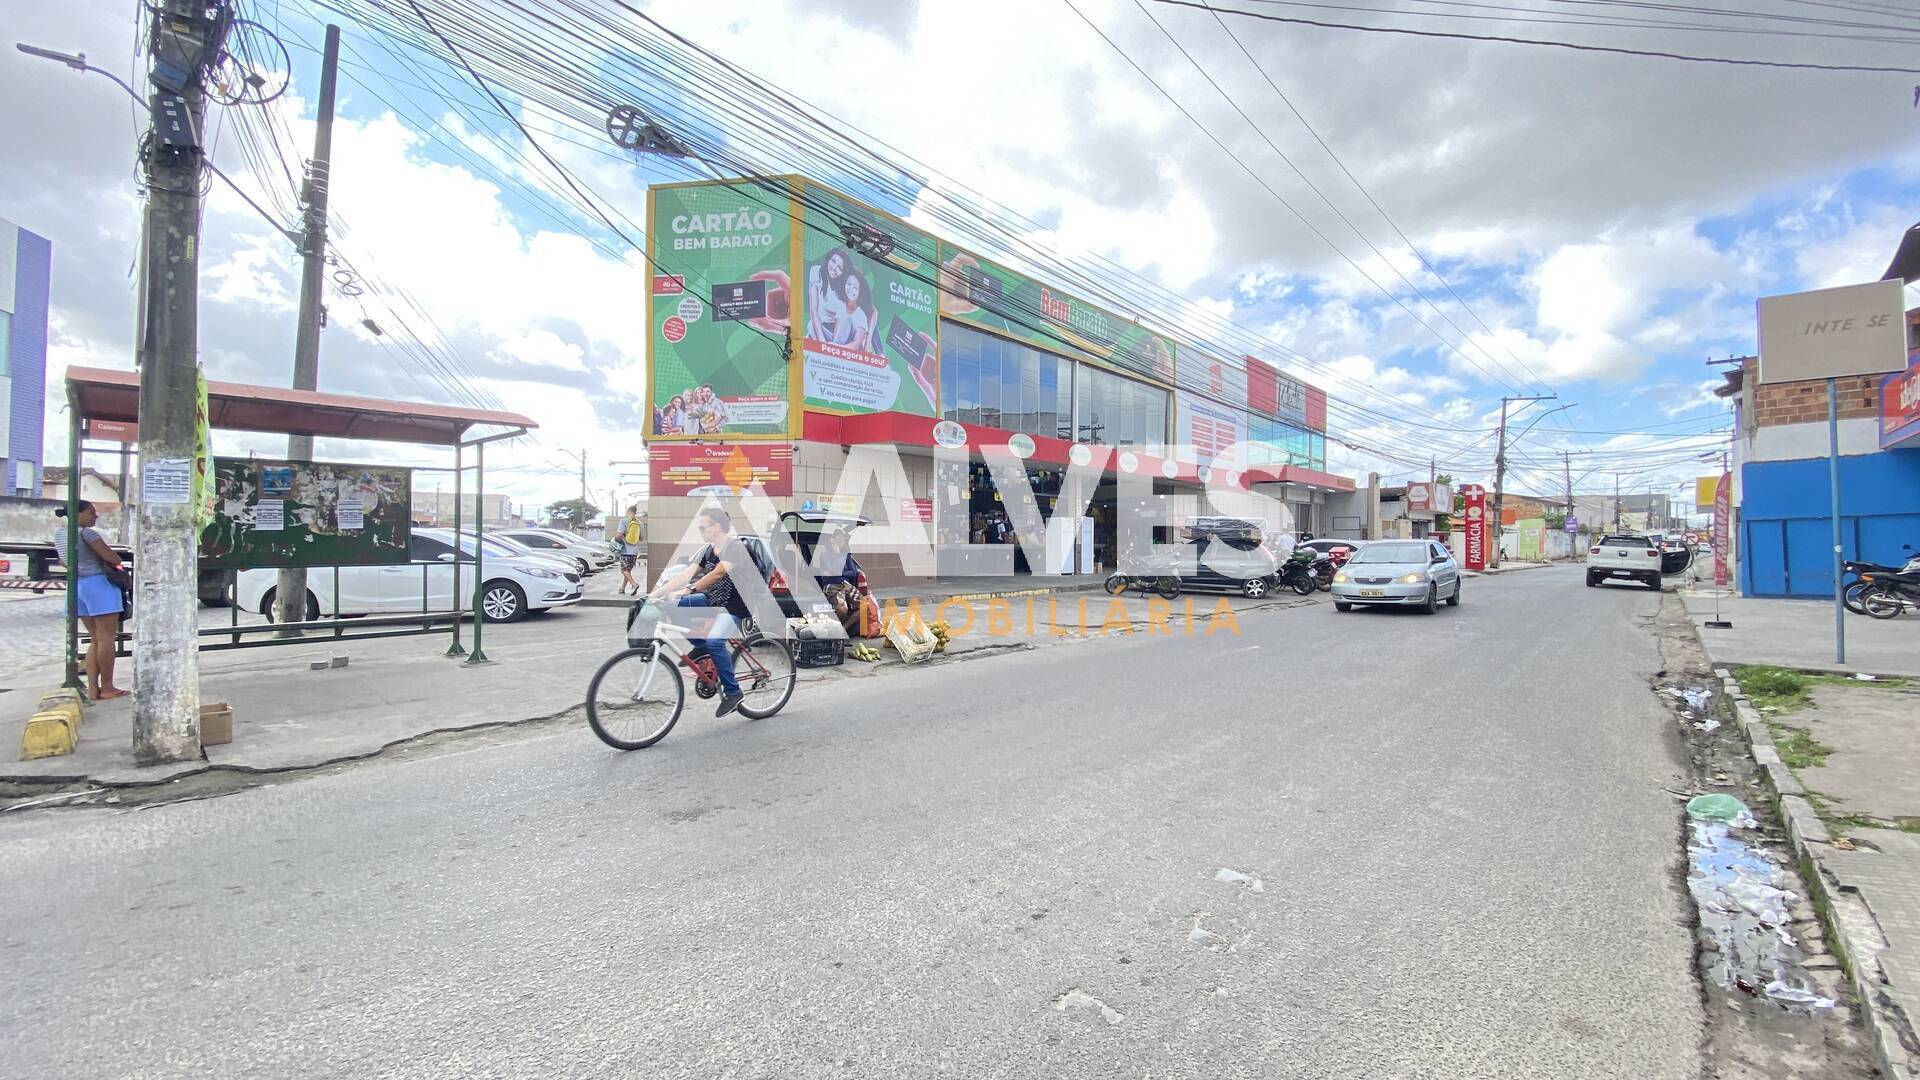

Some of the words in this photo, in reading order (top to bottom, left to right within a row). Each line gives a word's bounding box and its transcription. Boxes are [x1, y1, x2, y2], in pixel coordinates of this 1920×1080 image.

[672, 207, 772, 234] CARTÃO
[674, 237, 706, 250] BEM
[710, 234, 772, 249] BARATO
[890, 282, 932, 305] CARTÃO
[890, 294, 905, 305] BEM
[906, 300, 932, 314] BARATO
[1866, 314, 1892, 327] SE
[822, 344, 840, 355] Peça
[842, 349, 863, 360] agora
[871, 357, 885, 366] seu!
[1467, 522, 1480, 563] FARMÁCIA
